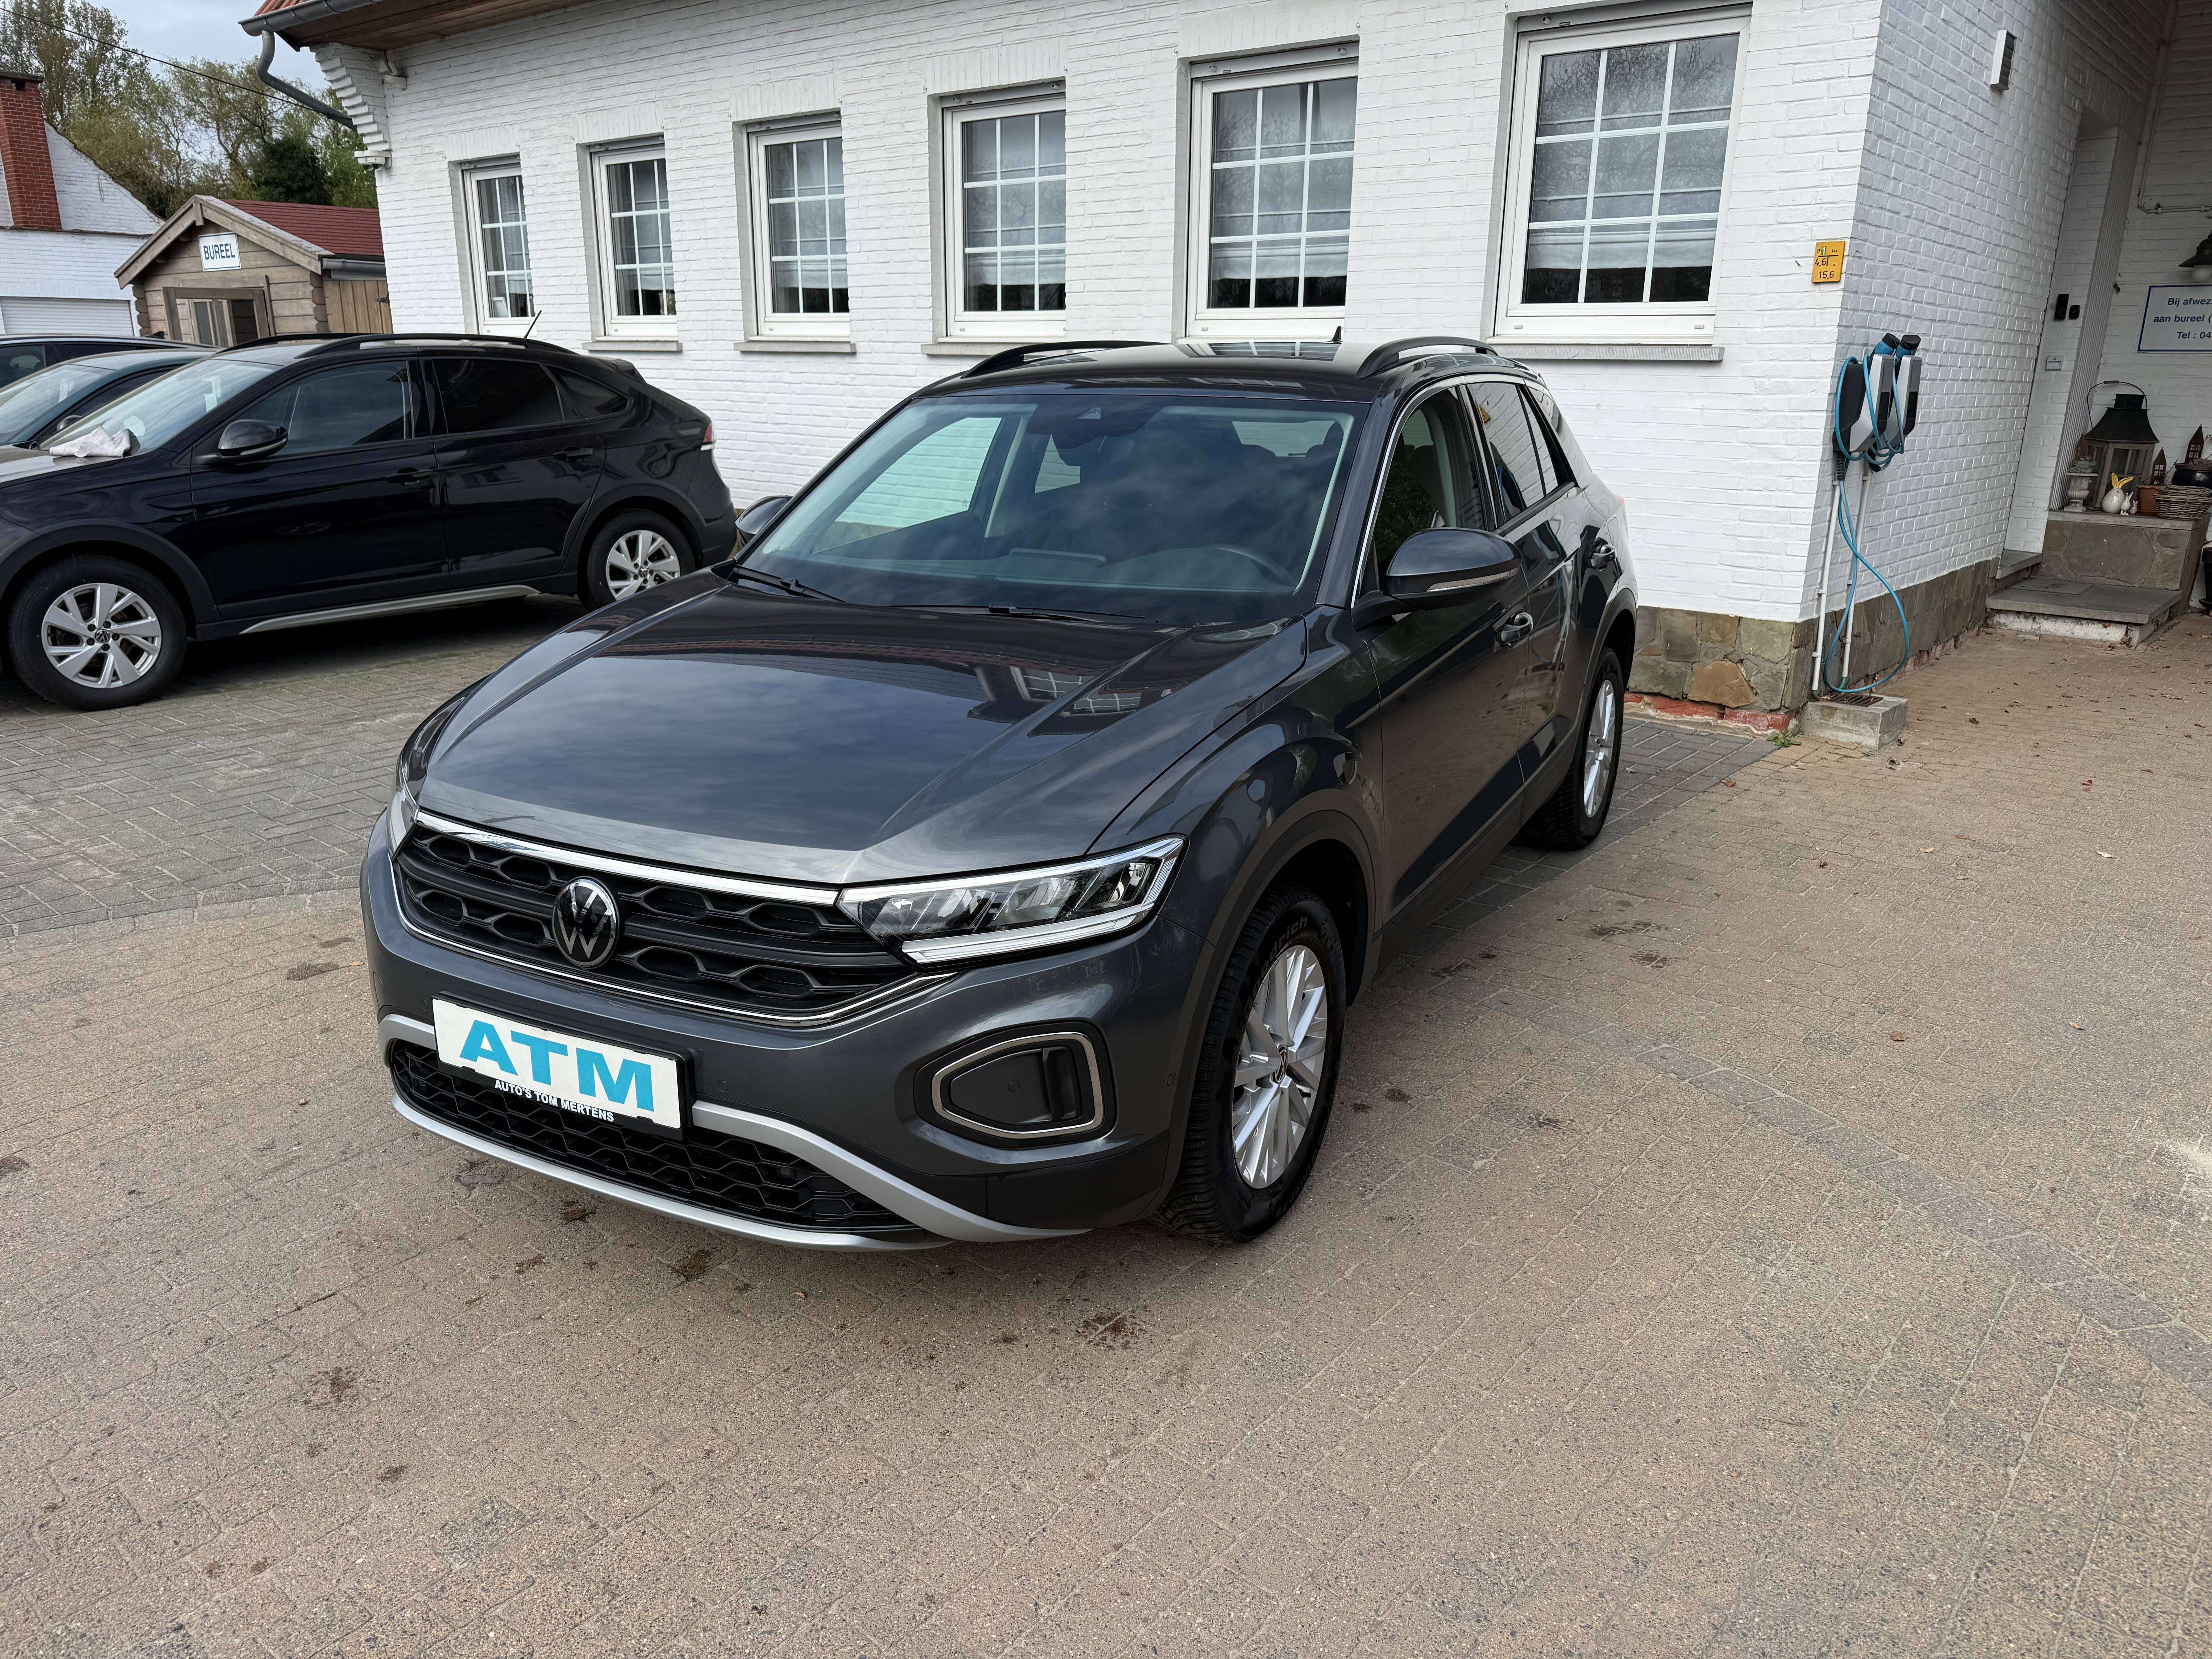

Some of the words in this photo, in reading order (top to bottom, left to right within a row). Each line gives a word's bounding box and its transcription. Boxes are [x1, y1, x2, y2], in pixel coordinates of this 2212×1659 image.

[203, 243, 235, 260] BUREEL
[1815, 258, 1826, 267] 4,6
[1819, 271, 1834, 280] 15,6
[2167, 297, 2180, 307] Bij
[460, 1019, 654, 1112] ATM
[495, 1079, 532, 1099] AUTO'S
[534, 1091, 558, 1107] TOM
[561, 1099, 614, 1122] MERTENS
